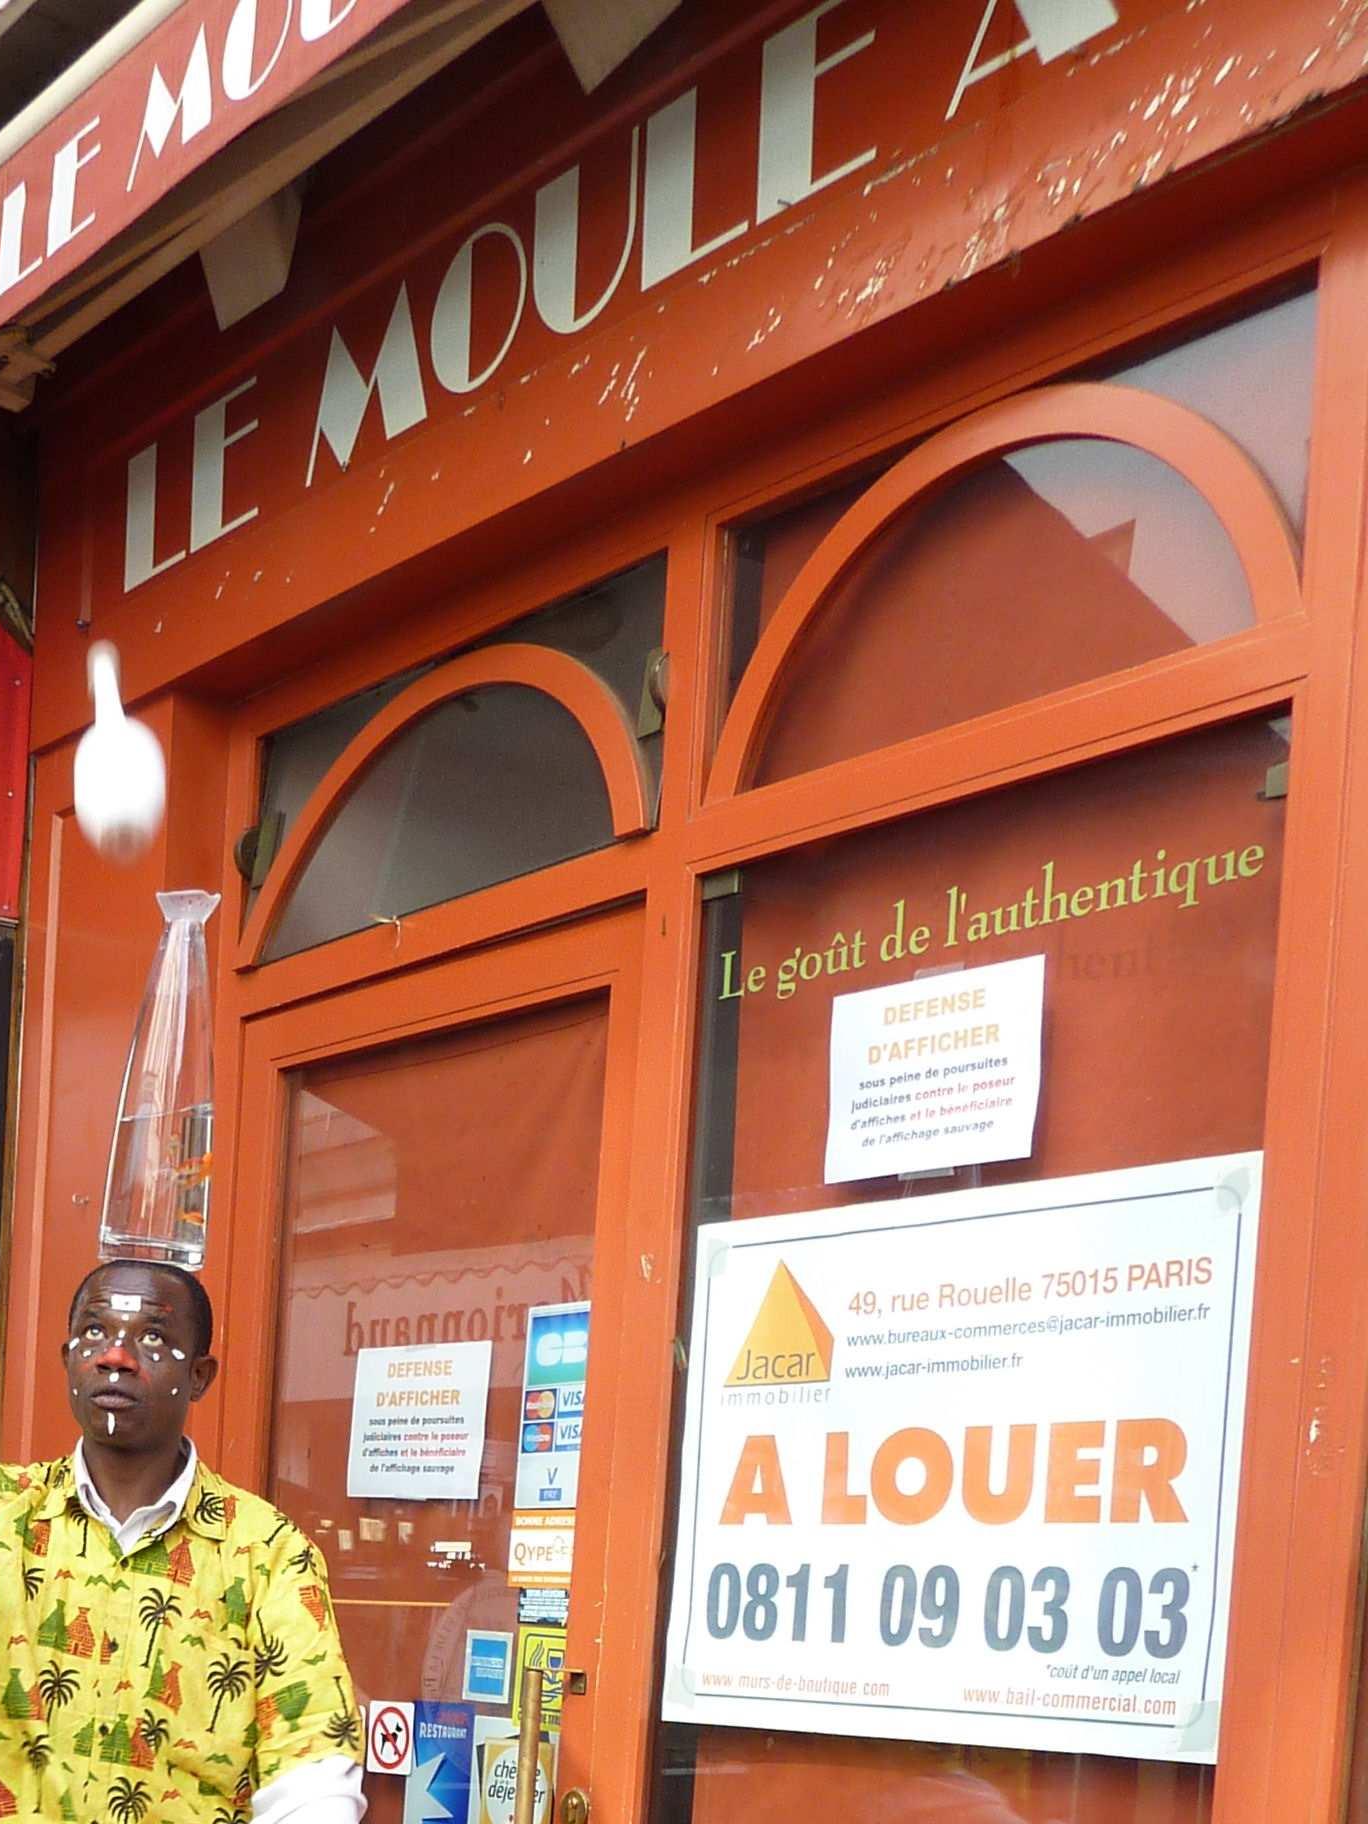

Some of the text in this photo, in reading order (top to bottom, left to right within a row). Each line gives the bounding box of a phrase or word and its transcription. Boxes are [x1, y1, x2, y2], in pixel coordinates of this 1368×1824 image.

[123, 375, 260, 593] LE
[305, 0, 877, 488] MOULE
[718, 844, 1265, 1000] Le goût de l'authentique
[883, 988, 986, 1026] DEFENSE
[868, 1023, 1000, 1066] D'AFFICHER
[859, 1056, 1008, 1090] sous peine de poursuites
[850, 1093, 911, 1114] judiciaires
[915, 1085, 953, 1101] contre
[972, 1076, 1015, 1095] poseur
[850, 1113, 906, 1131] d'affiches
[910, 1110, 921, 1121] et
[862, 1135, 875, 1148] de
[943, 1118, 994, 1135] sauvage
[848, 1256, 1214, 1318] 49, rue Rouelle 75015 PARIS
[387, 1359, 453, 1379] DEFENSE
[736, 1347, 816, 1382] Jacar
[376, 1389, 461, 1408] D'AFFICHER
[562, 1391, 585, 1408] VIS
[720, 1385, 832, 1408] immobilier
[560, 1424, 583, 1439] VIS
[718, 1417, 1190, 1526] A LOUER
[705, 1562, 850, 1644] 0811
[879, 1563, 960, 1649] 09
[983, 1565, 1071, 1654] 03
[1081, 1663, 1110, 1682] d'un
[1111, 1667, 1147, 1687] appel
[1149, 1667, 1181, 1685] local
[494, 1758, 541, 1783] chèe
[488, 1780, 545, 1804] déjeer
